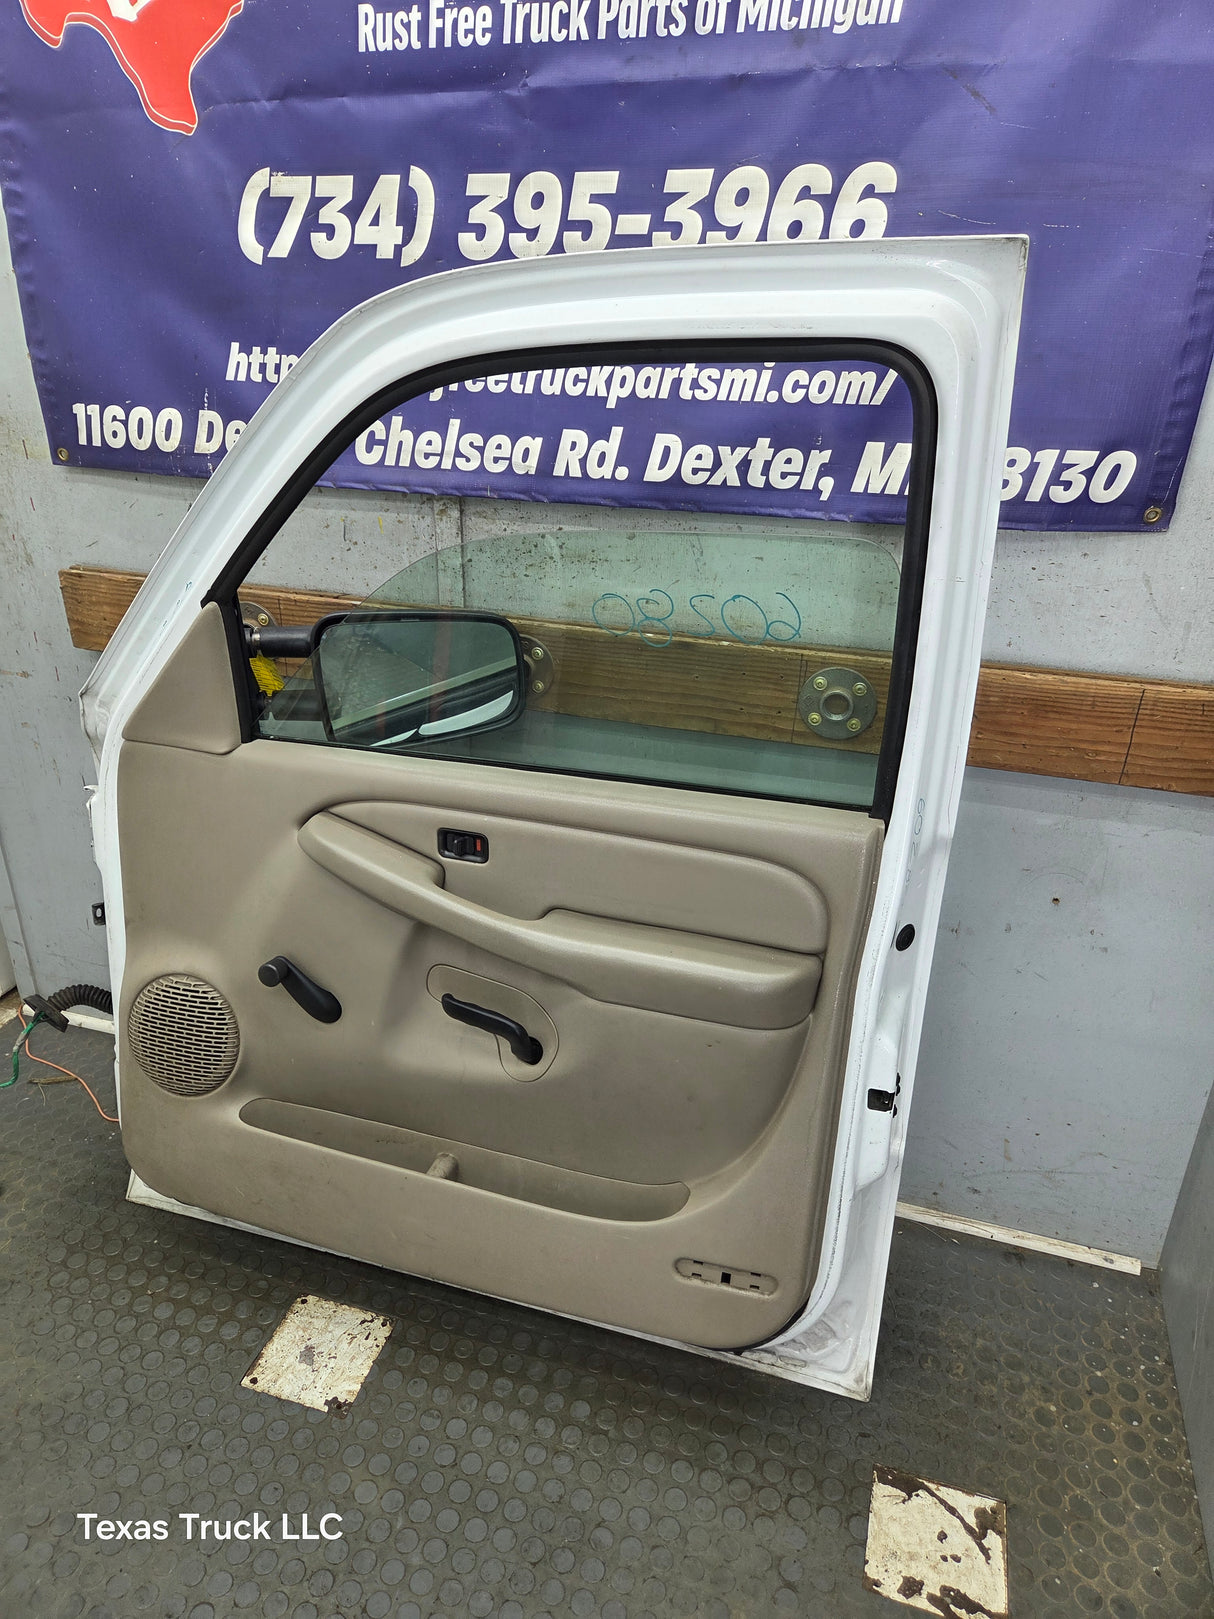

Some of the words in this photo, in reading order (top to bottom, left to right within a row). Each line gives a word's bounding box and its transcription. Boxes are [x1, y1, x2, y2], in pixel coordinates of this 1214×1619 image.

[358, 3, 421, 52] Rust
[428, 0, 493, 48] Free
[503, 0, 590, 44] Truck
[597, 0, 689, 39] Parts
[694, 0, 732, 36] of
[736, 0, 902, 34] Michigan
[237, 165, 435, 267] (734)
[458, 162, 897, 260] 395-3966
[72, 403, 183, 452] 11600
[355, 417, 543, 475] Chelsea
[553, 426, 629, 481] Rd.
[643, 432, 834, 501] Dexter,
[850, 441, 912, 496] M
[1000, 447, 1137, 503] 8130
